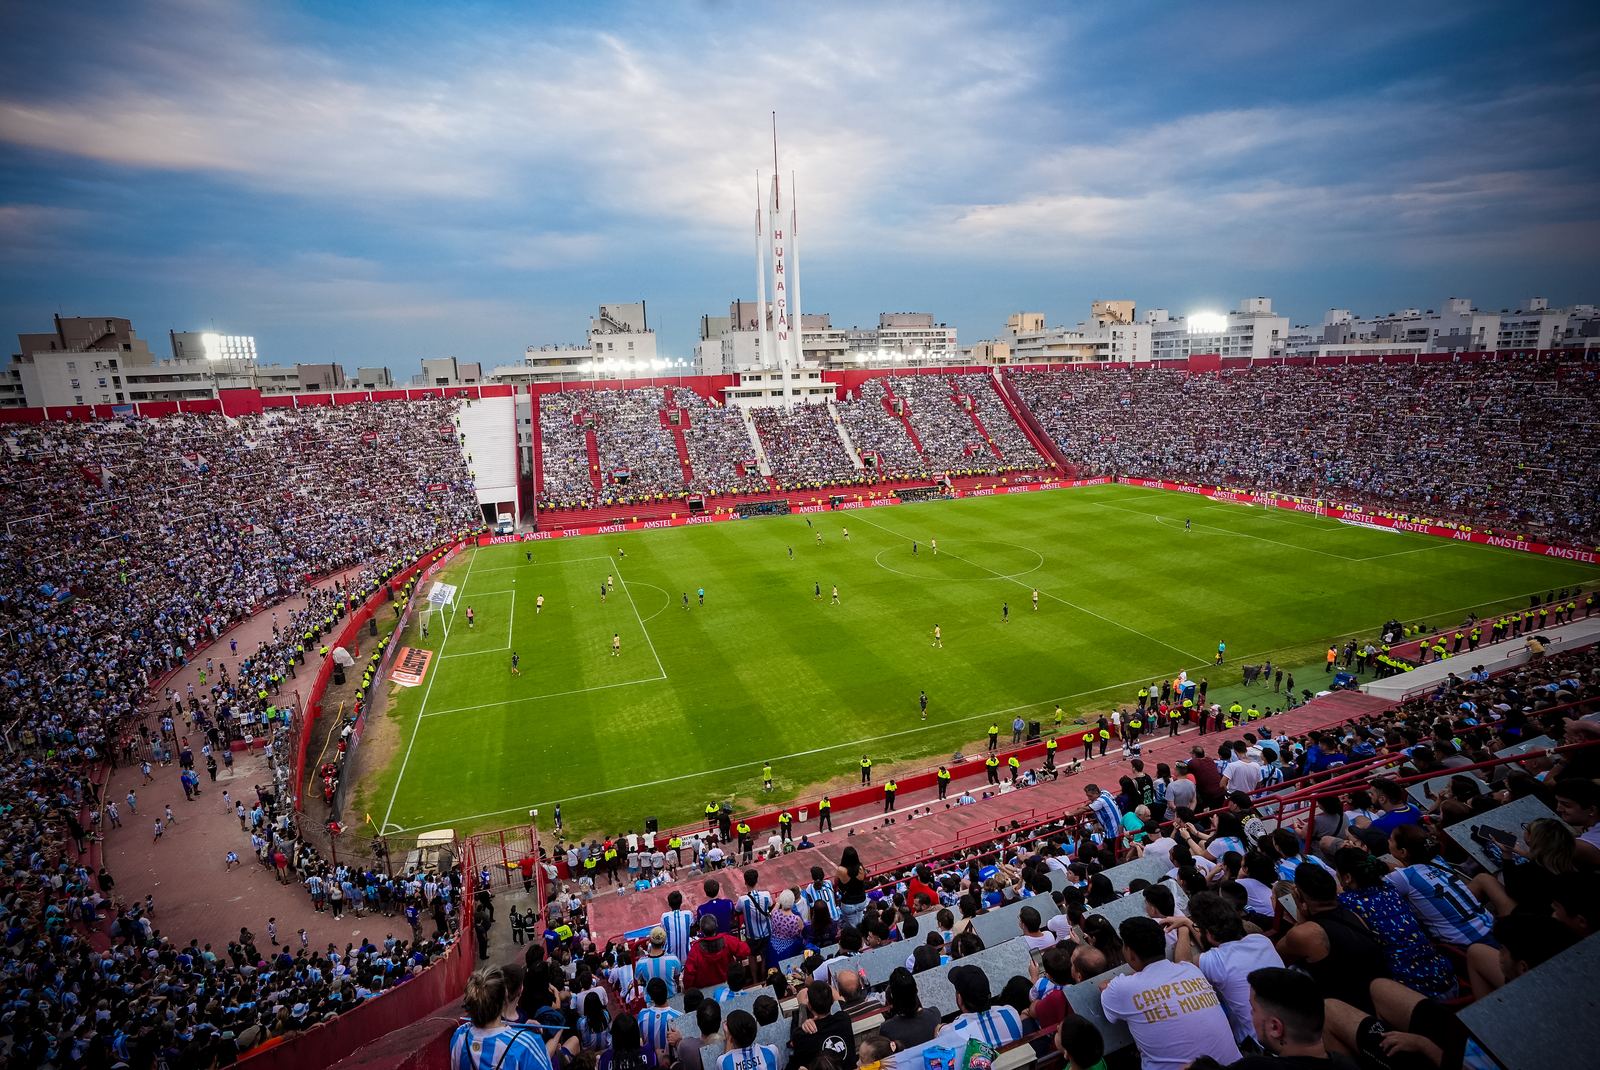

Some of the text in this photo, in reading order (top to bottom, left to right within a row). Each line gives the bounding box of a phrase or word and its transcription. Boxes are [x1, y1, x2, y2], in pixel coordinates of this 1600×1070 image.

[774, 230, 787, 341] HURACAN
[1007, 485, 1029, 493] AMSTEL
[1086, 478, 1105, 486] AMSTEL
[799, 505, 824, 513] AMSTEL
[490, 534, 516, 544] AMSTEL
[525, 531, 552, 540] AMSTEL
[598, 524, 627, 534] AMSTEL
[644, 519, 672, 529] AMSTEL
[686, 515, 713, 524] AMSTEL
[1142, 480, 1164, 488] AMSTEL
[1177, 485, 1200, 494] AMSTEL
[1212, 490, 1237, 500] AMSTEL
[1295, 503, 1324, 515] AMSTEL
[1342, 511, 1375, 524] AMSTEL
[1391, 520, 1429, 534] AMSTEL
[1453, 530, 1471, 541] AM
[1486, 535, 1530, 552] AMSTEL
[1545, 545, 1595, 563] AMSTEL
[1143, 1003, 1178, 1024] DEL
[736, 1055, 761, 1070] MESSI
